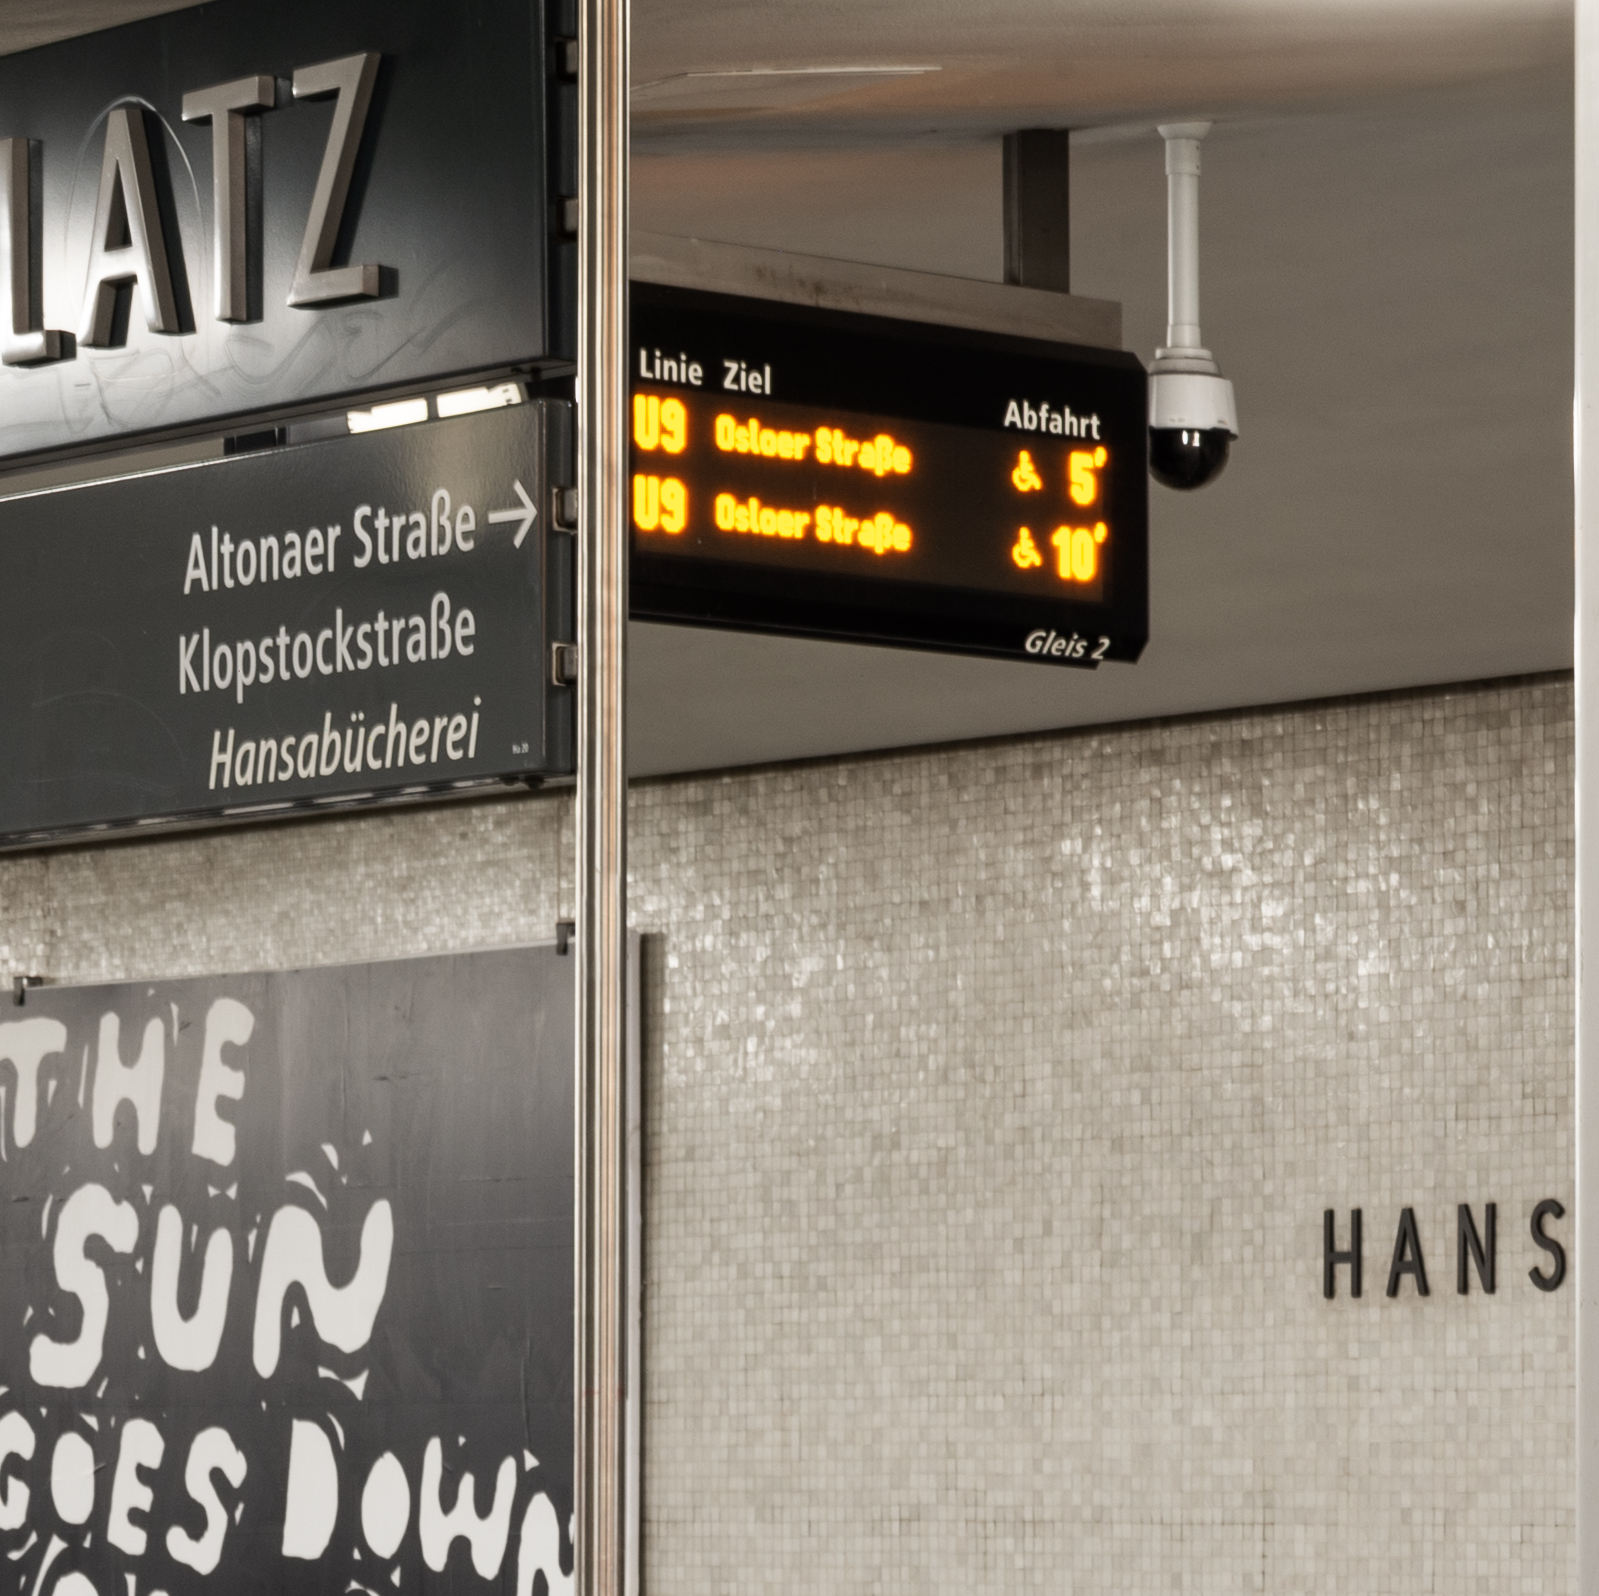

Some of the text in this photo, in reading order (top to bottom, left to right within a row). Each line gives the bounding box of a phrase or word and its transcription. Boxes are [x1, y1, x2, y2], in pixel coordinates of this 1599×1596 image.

[0, 52, 384, 367] LATZ
[639, 347, 771, 395] Linie Ziel
[1003, 399, 1101, 440] Abfahrt
[633, 393, 687, 454] U9
[715, 413, 811, 460] Osloer
[815, 426, 912, 477] Straße
[184, 488, 476, 594] Altonaer Straße
[633, 473, 687, 534] U9
[715, 493, 811, 539] Osloer
[815, 504, 912, 555] Straße
[179, 591, 476, 703] Klopstockstraße
[1024, 628, 1111, 660] Gleis 2
[208, 695, 481, 790] Hansabücherei
[0, 998, 255, 1167] THE
[29, 1183, 394, 1389] SUN
[1323, 1197, 1567, 1300] HANS
